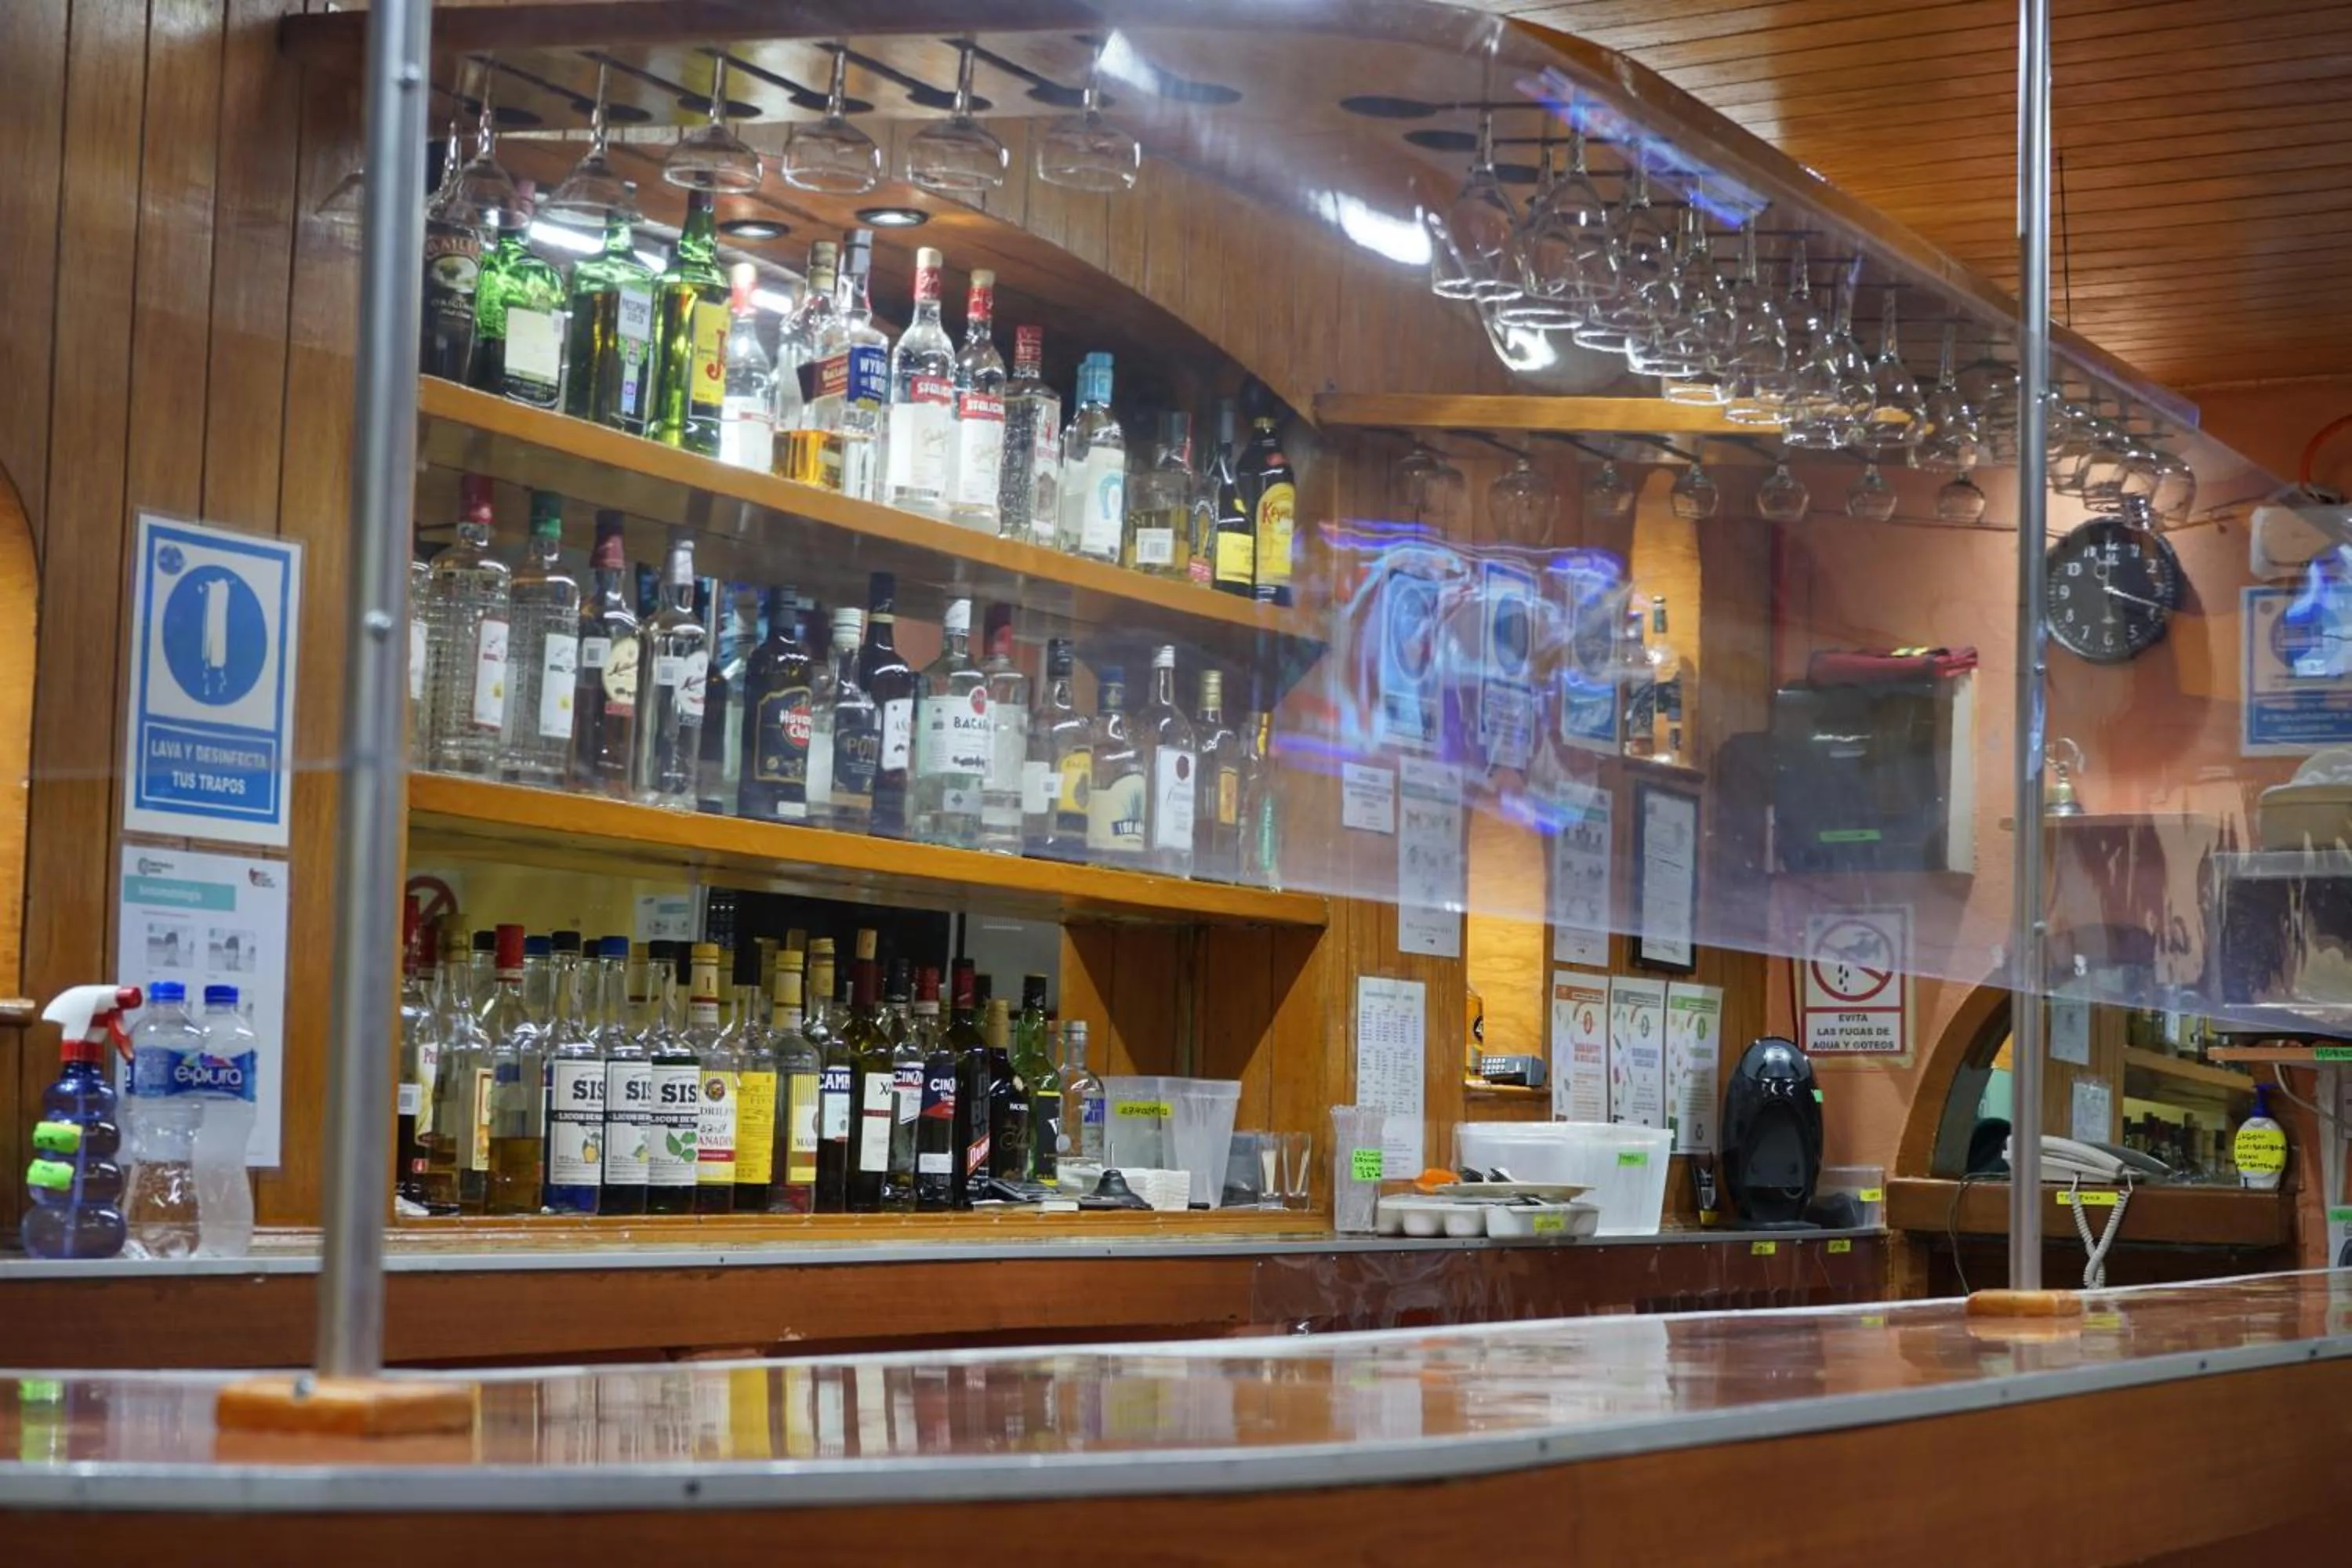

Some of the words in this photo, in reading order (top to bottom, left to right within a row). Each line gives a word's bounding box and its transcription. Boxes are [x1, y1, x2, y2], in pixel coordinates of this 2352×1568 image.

[151, 740, 181, 758] LAVA
[184, 743, 193, 760] Y
[172, 770, 196, 789] TUS
[198, 773, 246, 794] TRAPOS
[1876, 1027, 1891, 1036] DE
